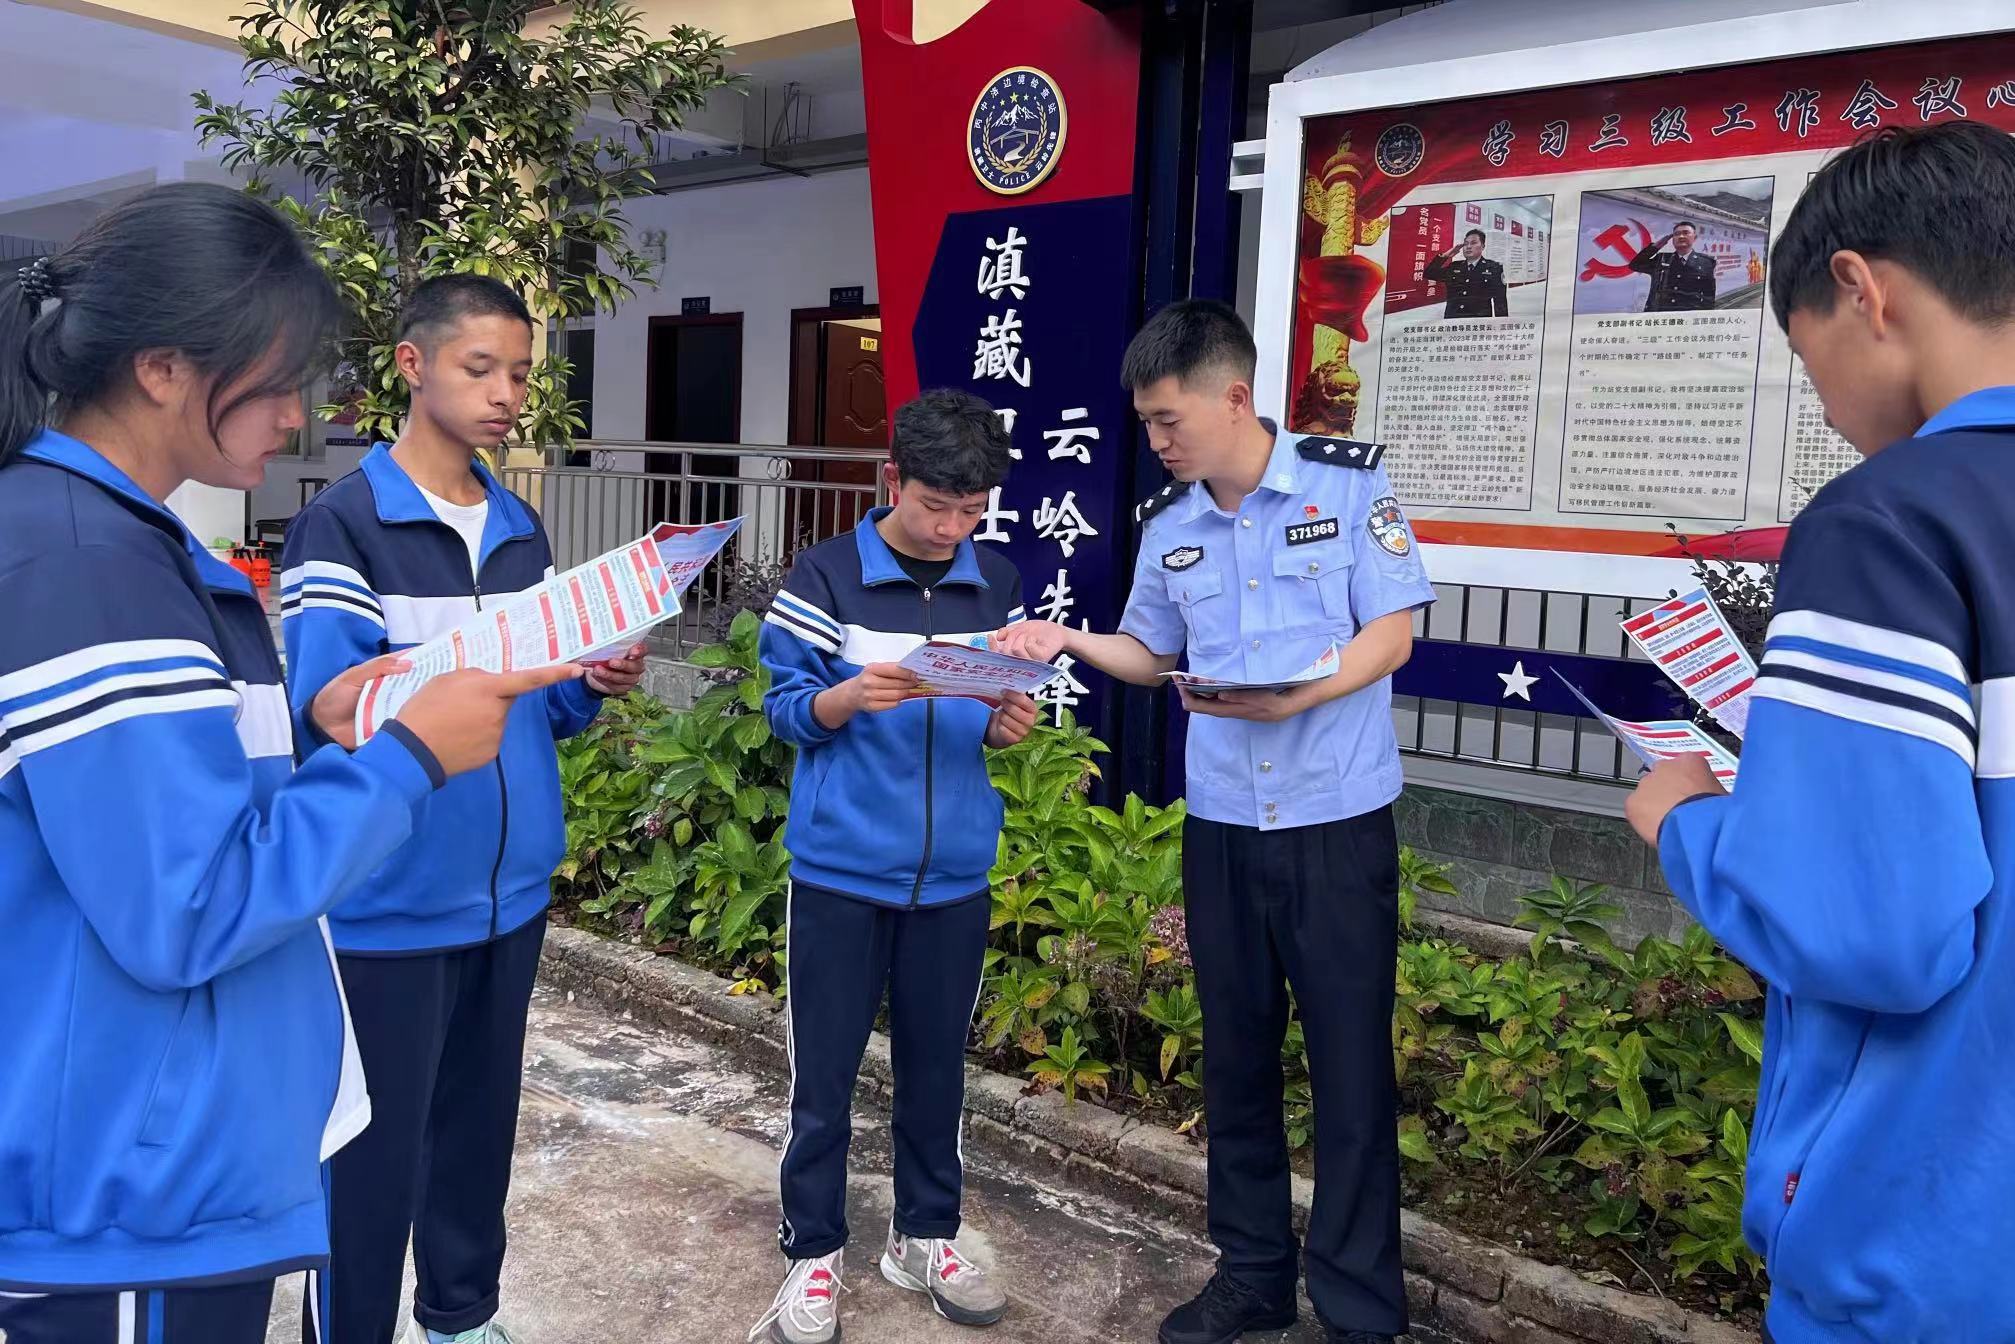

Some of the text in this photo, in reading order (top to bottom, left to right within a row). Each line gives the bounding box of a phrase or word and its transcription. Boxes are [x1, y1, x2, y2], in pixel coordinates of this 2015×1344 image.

[998, 172, 1032, 185] POLICE
[1597, 319, 1643, 328] 党支部副书记
[863, 339, 875, 349] 107
[1289, 522, 1336, 542] 371968
